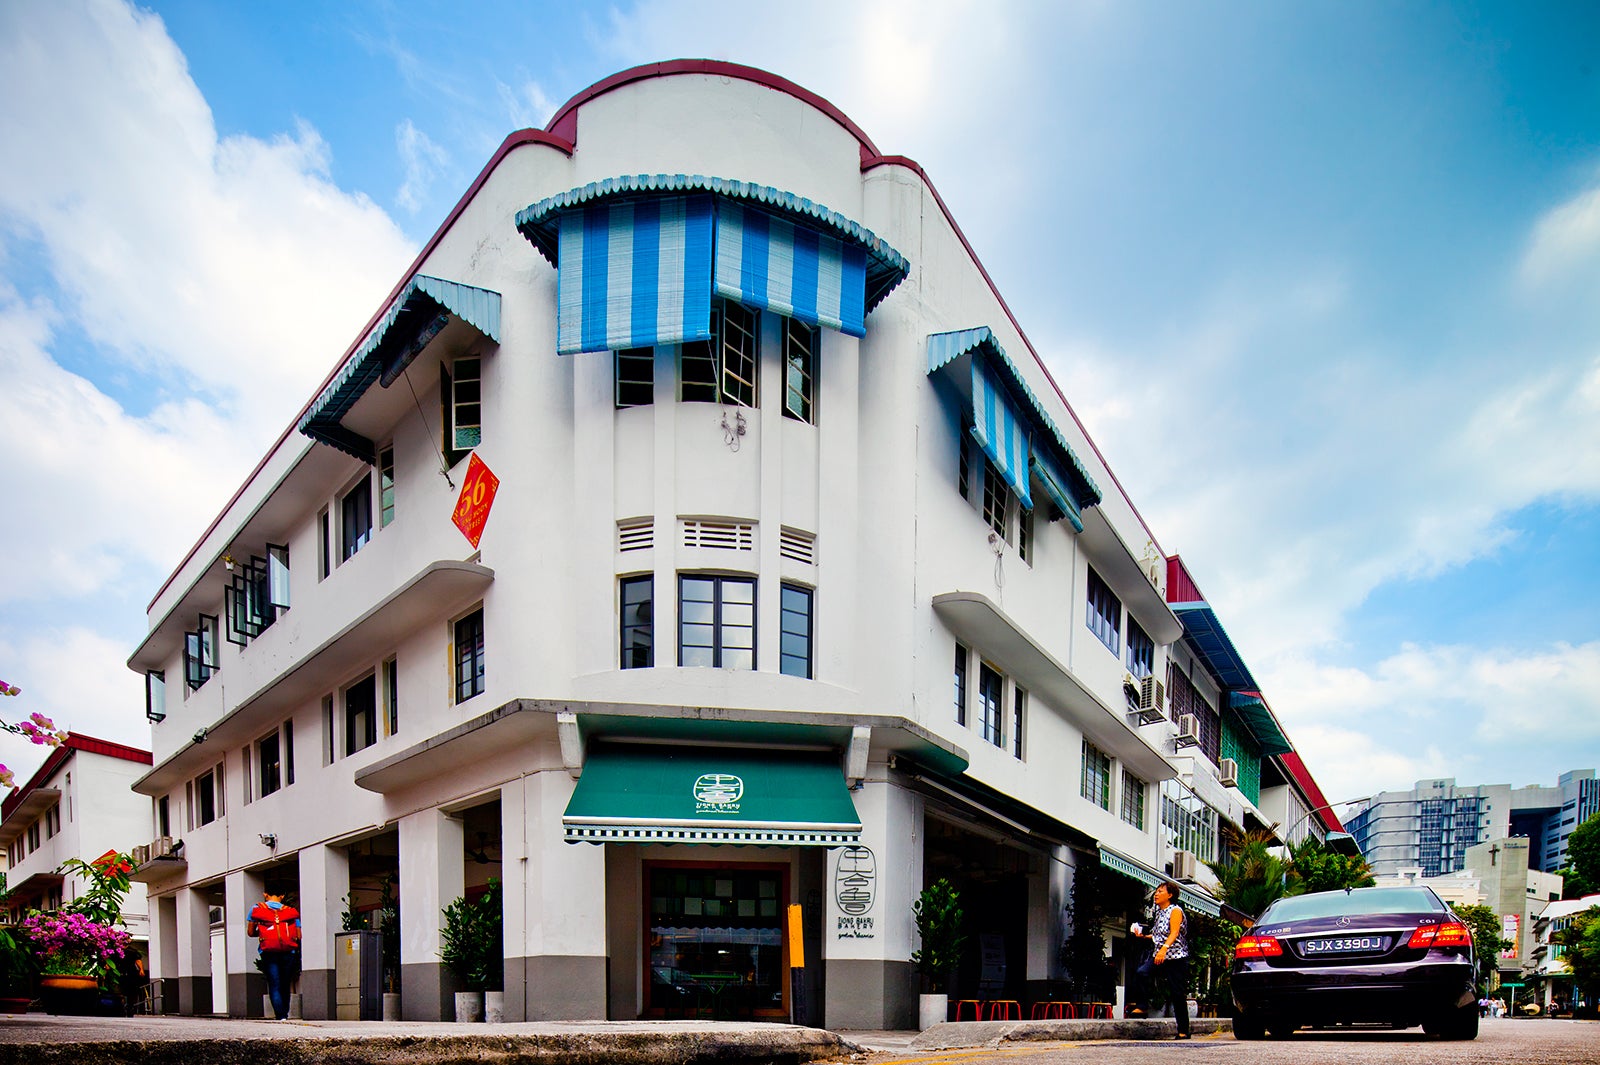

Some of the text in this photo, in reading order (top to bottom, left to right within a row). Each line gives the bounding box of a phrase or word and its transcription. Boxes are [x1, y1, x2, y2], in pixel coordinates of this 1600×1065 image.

[460, 470, 486, 517] 56
[1307, 937, 1381, 951] SJX 3390 J
